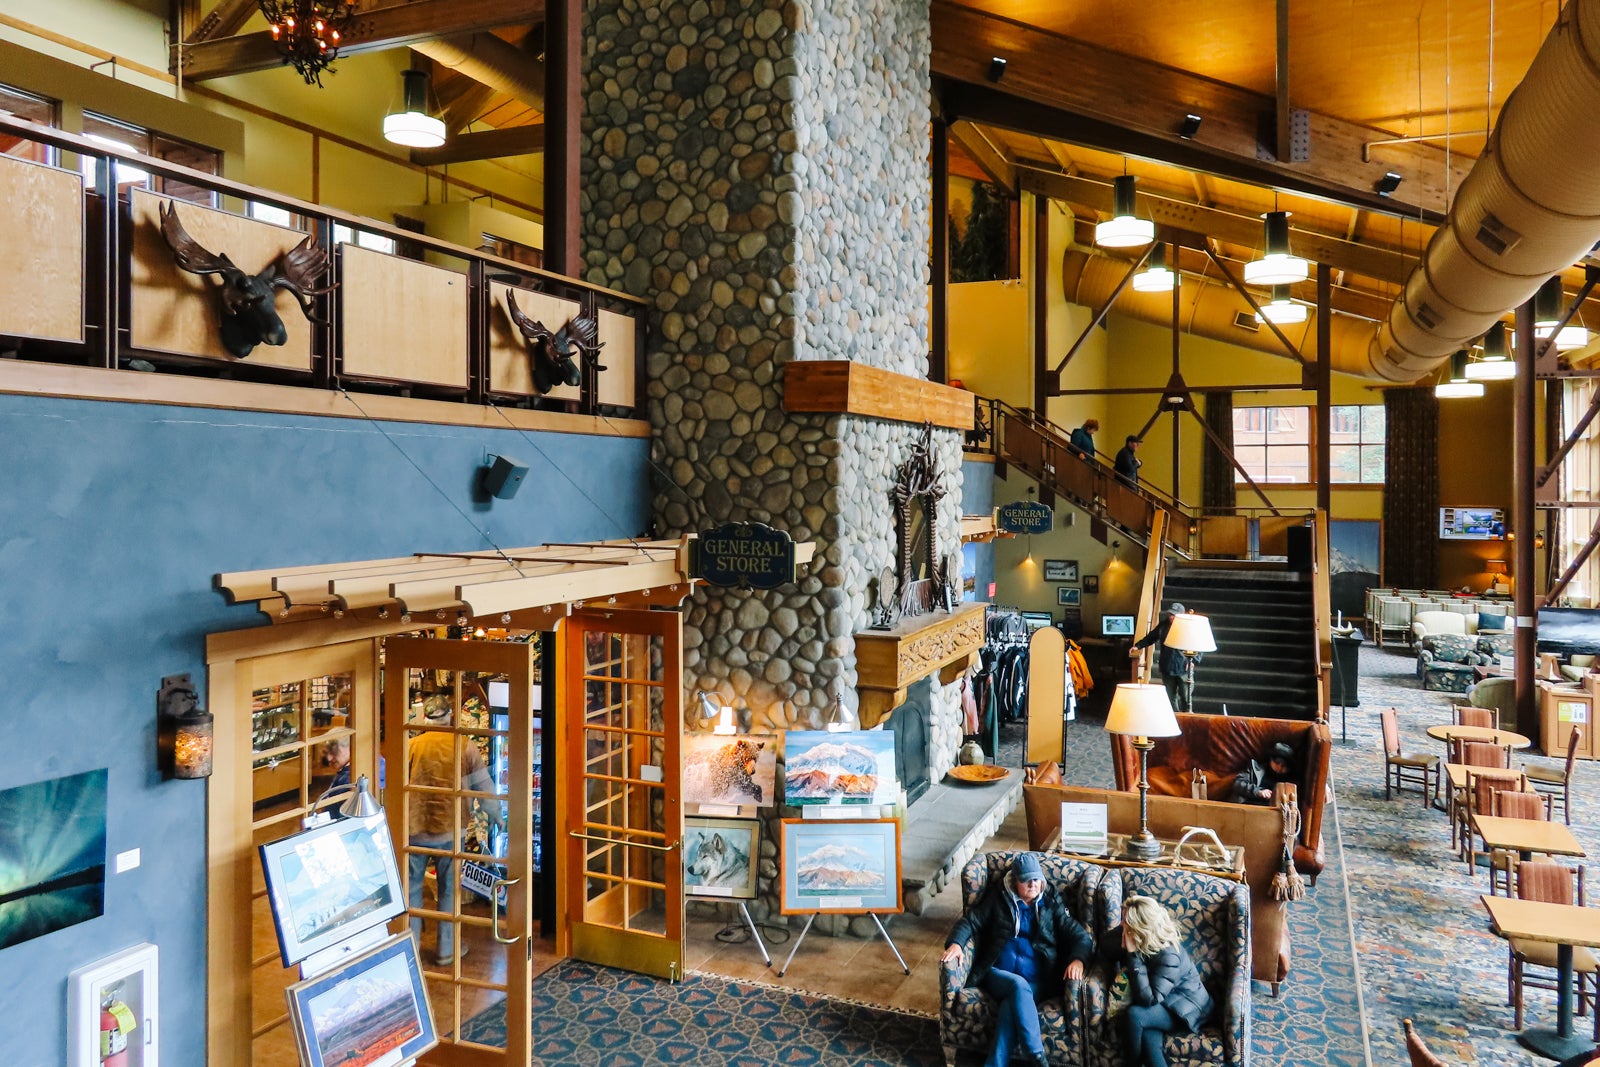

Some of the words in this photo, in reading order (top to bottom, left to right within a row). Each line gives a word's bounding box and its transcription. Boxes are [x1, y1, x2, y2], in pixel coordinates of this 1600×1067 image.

[1005, 509, 1047, 518] GENERAL
[1011, 518, 1040, 526] STORE
[705, 539, 785, 557] GENERAL
[716, 557, 772, 573] STORE
[465, 865, 493, 888] CLOSED
